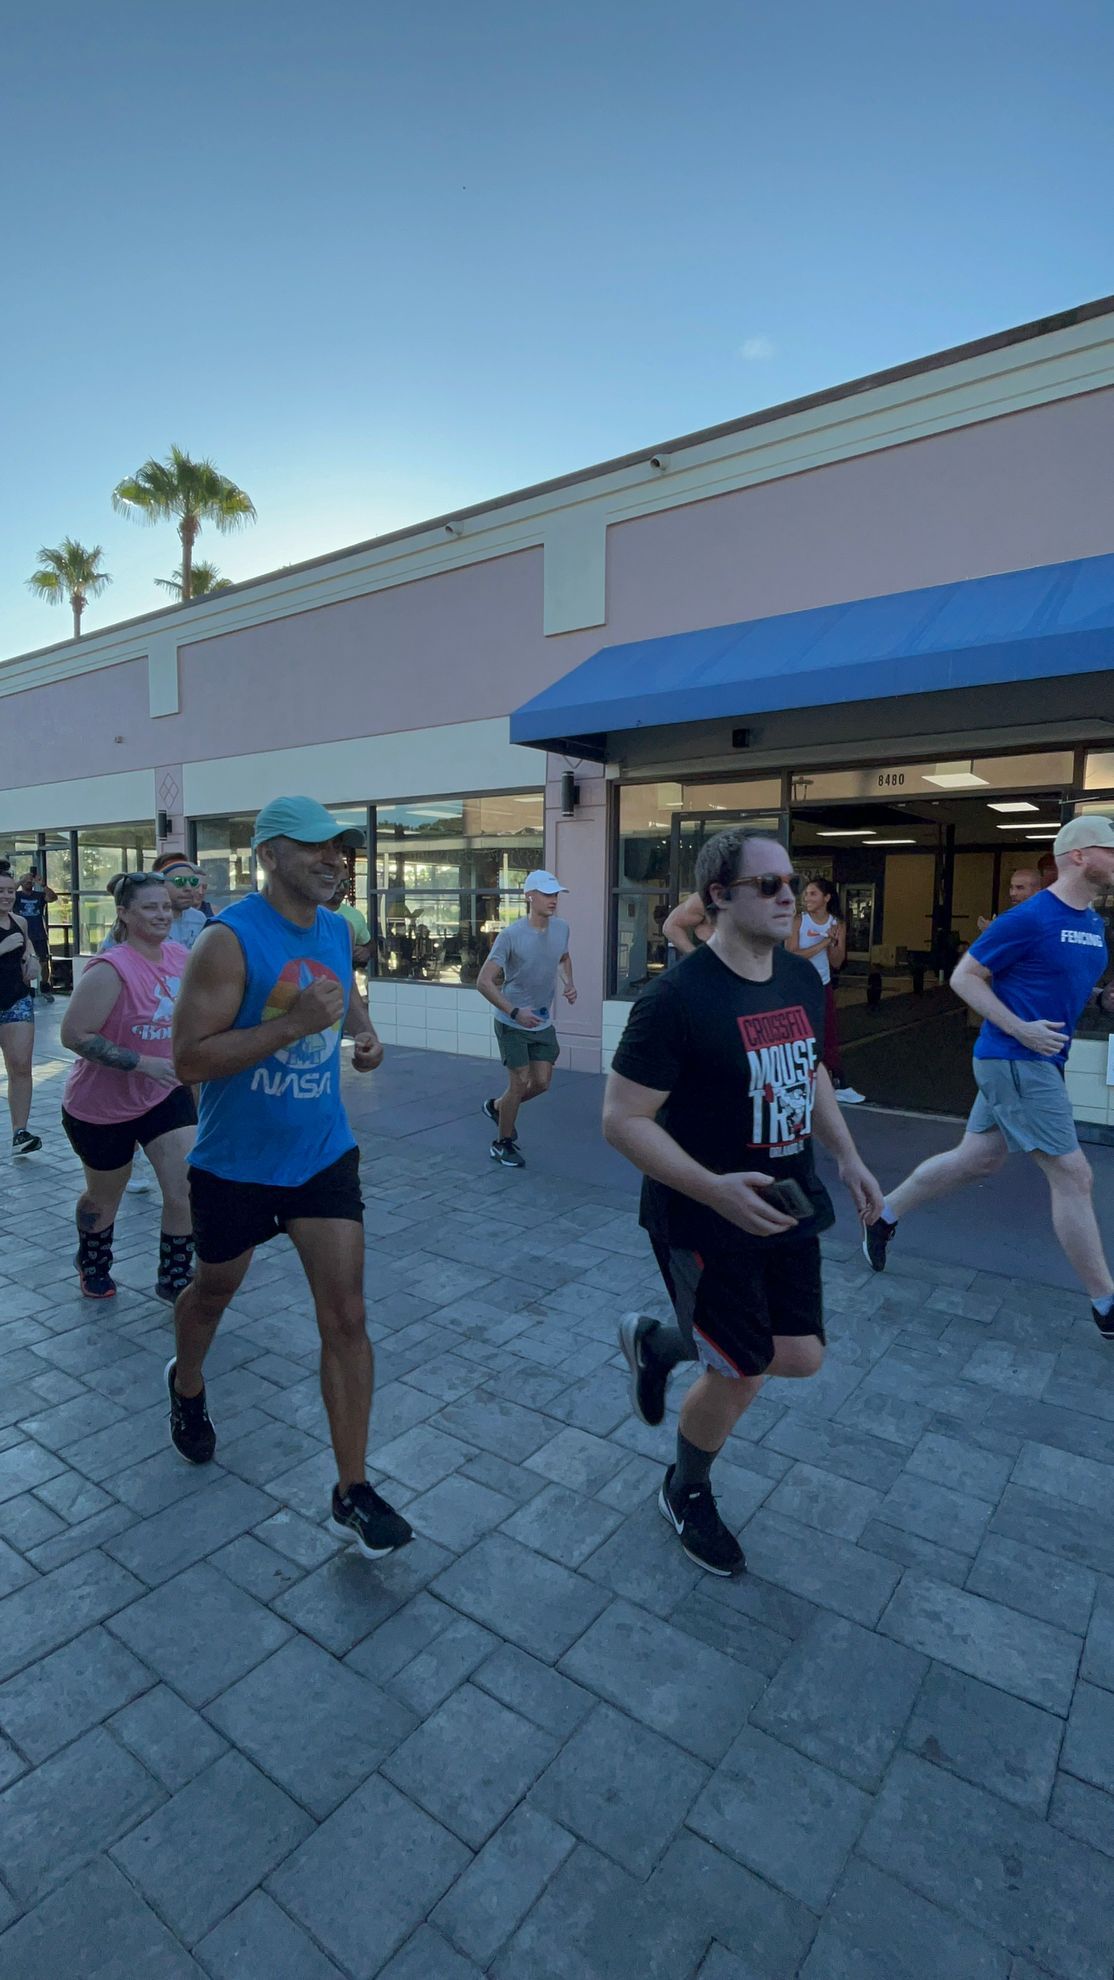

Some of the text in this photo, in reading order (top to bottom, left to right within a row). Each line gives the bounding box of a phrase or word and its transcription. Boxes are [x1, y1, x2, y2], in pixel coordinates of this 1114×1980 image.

[878, 773, 905, 787] 8480
[1060, 929, 1103, 947] FENCING
[742, 1009, 810, 1047] CROSSFIT
[746, 1037, 817, 1091] MOUSE
[250, 1067, 332, 1099] NASA
